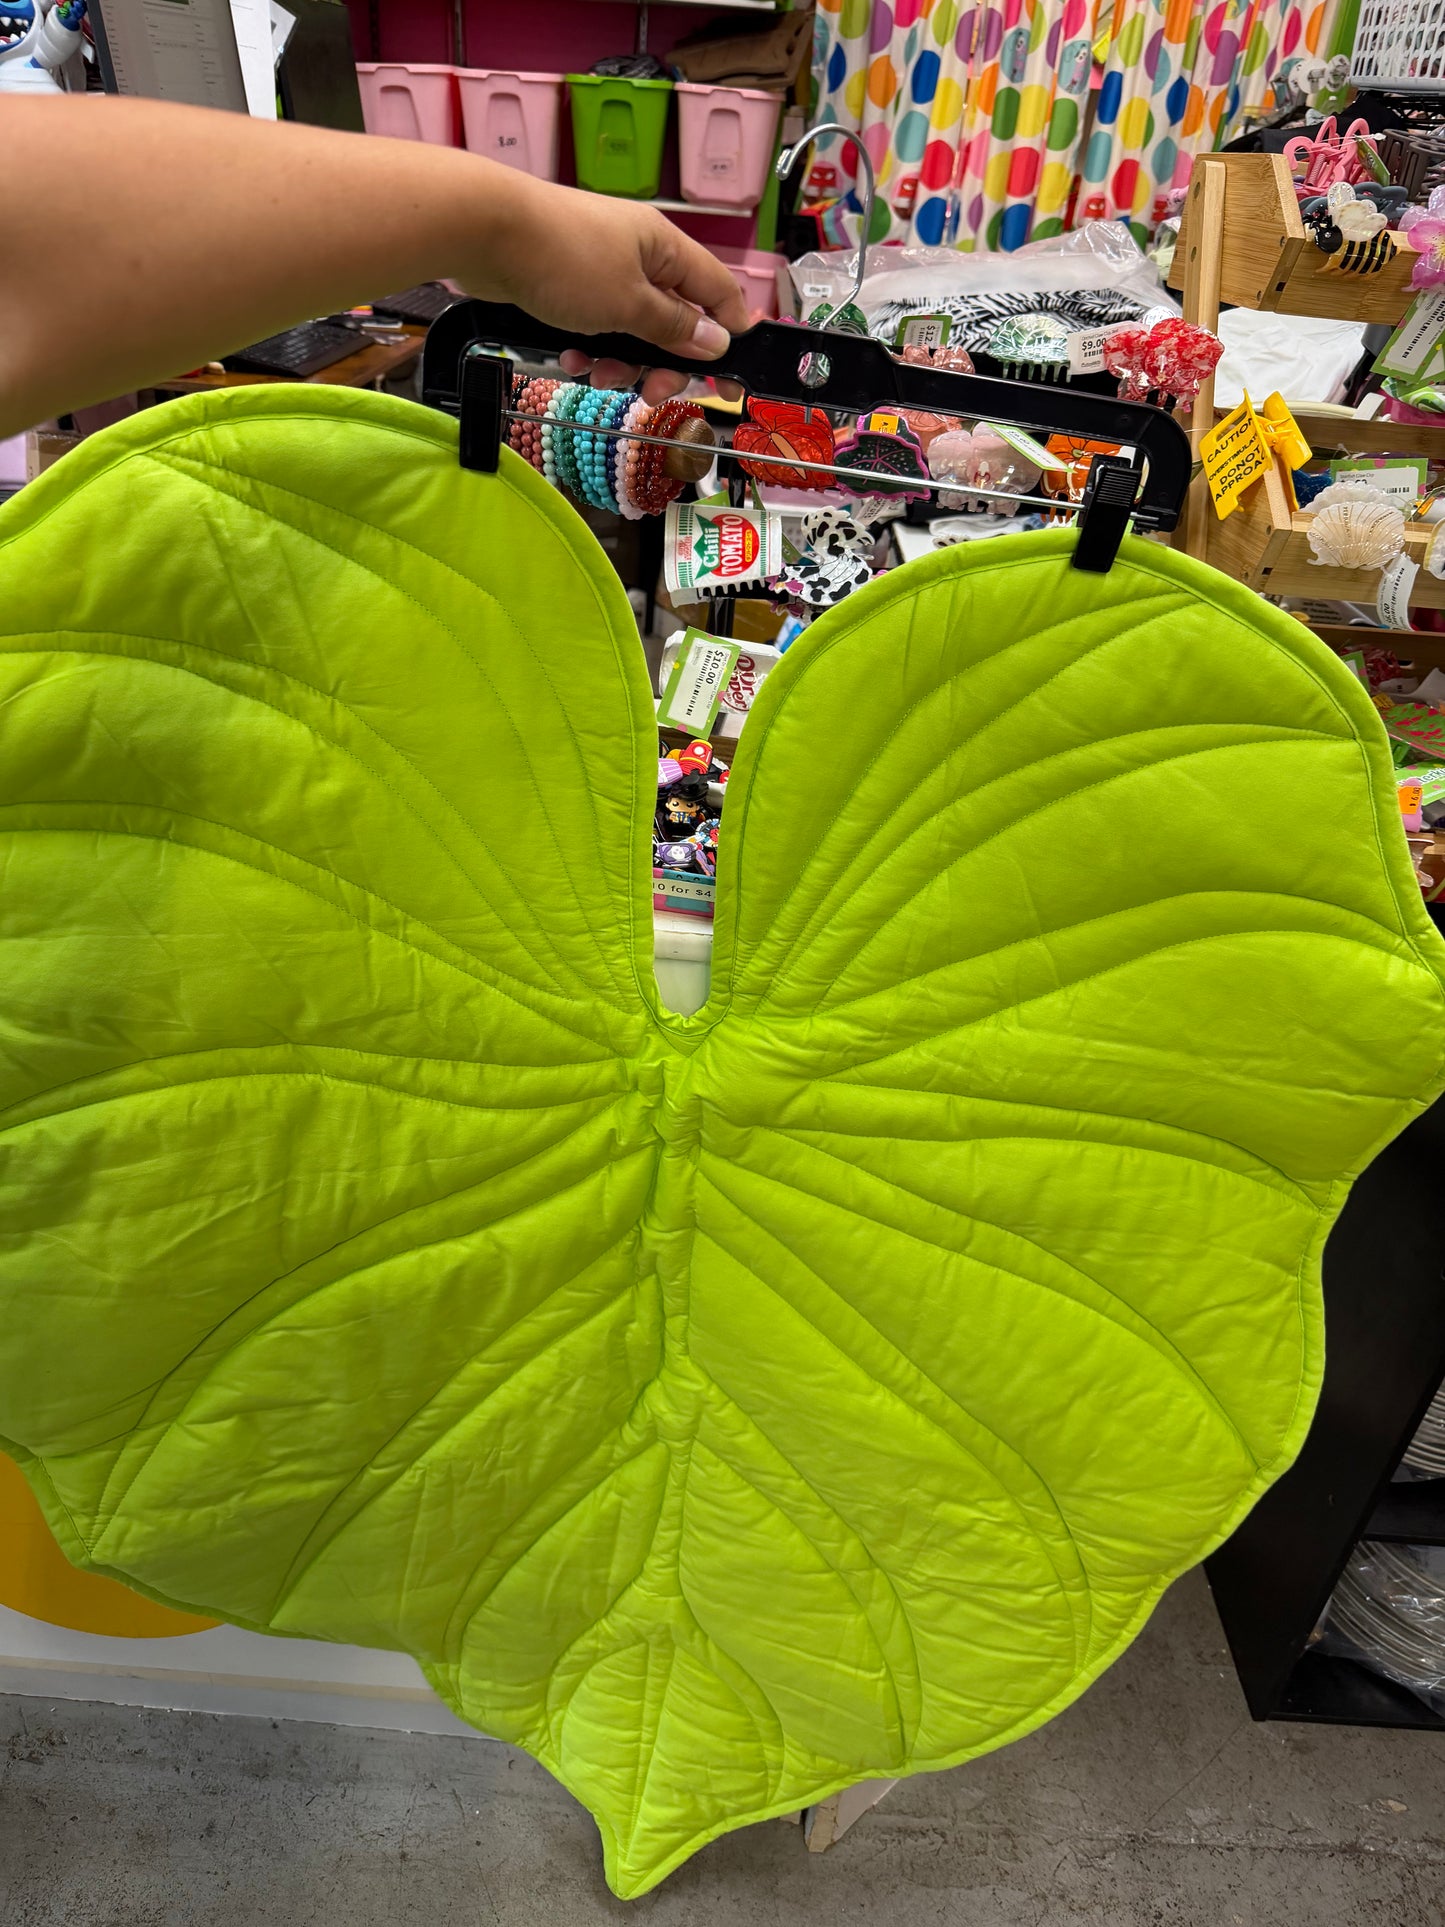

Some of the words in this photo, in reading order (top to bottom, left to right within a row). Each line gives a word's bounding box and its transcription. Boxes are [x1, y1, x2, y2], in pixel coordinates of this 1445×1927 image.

[925, 325, 936, 345] $12.
[1081, 338, 1107, 351] $9.00
[1208, 433, 1257, 481] OVERSTIMULAT
[703, 527, 719, 568] Chili
[721, 515, 743, 575] TOMATO
[706, 650, 724, 684] $10.00
[671, 885, 689, 893] for
